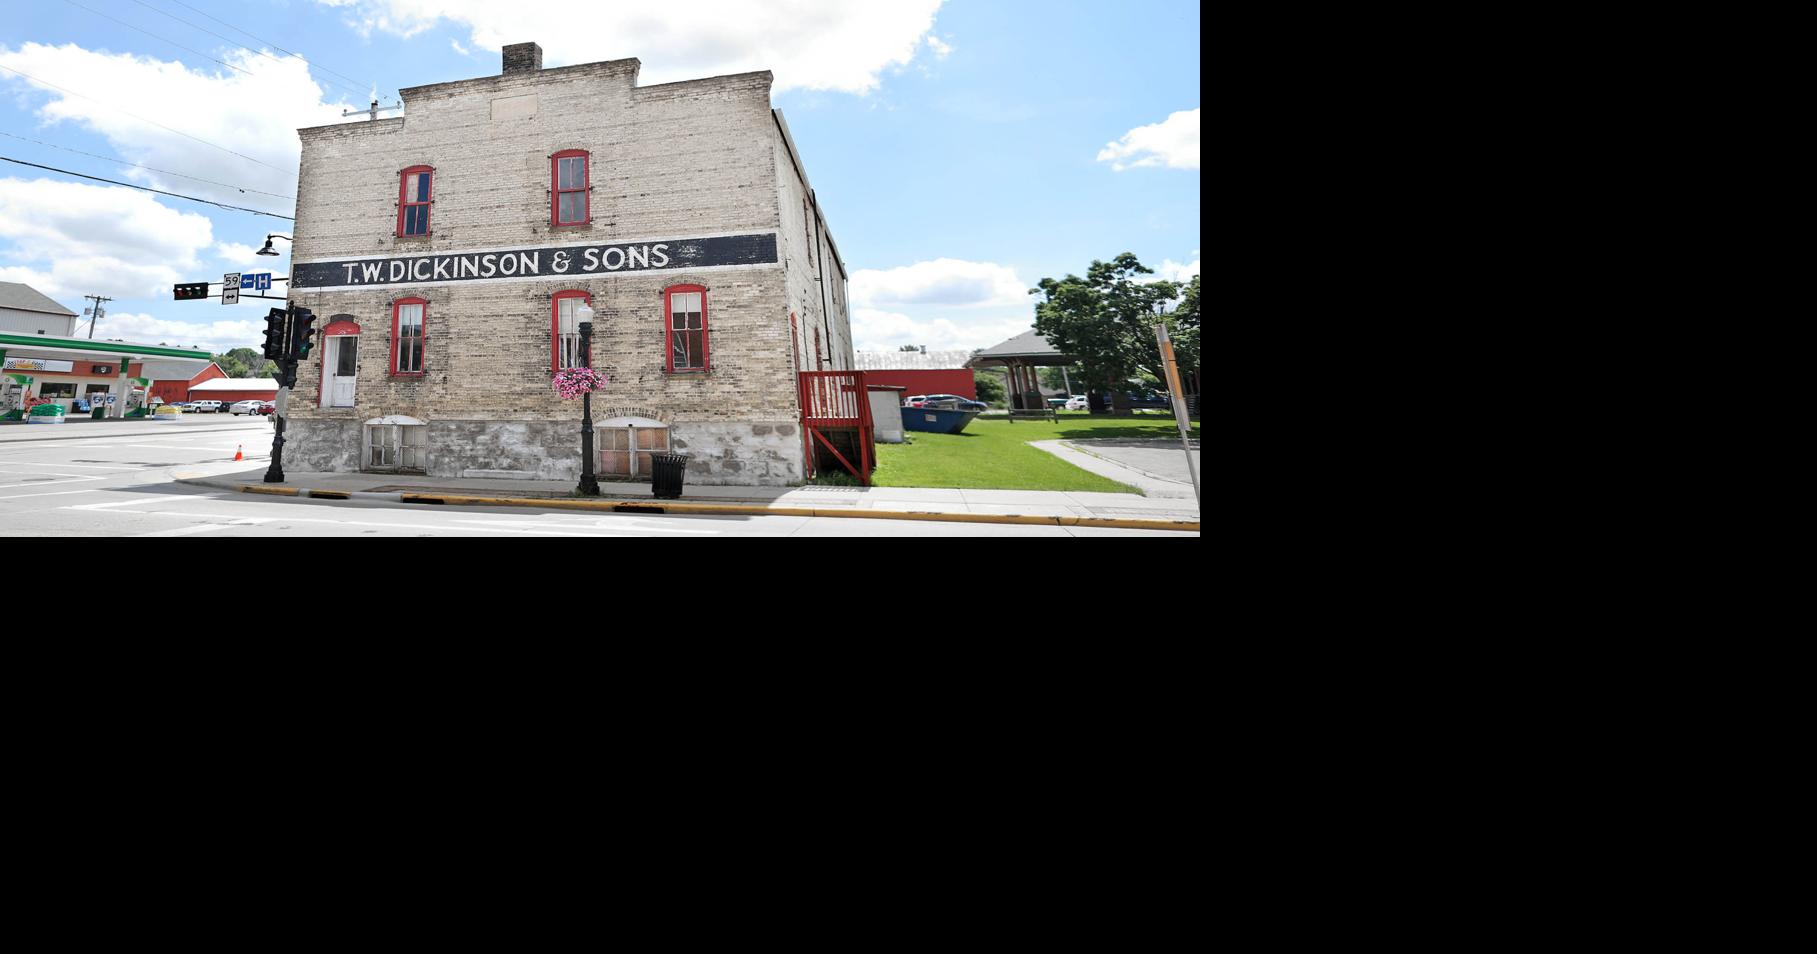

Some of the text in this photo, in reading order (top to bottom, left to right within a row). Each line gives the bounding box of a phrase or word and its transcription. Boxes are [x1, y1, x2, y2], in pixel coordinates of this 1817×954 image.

[551, 250, 572, 273] &
[582, 243, 669, 272] SONS
[225, 276, 239, 287] 59
[258, 275, 268, 288] H
